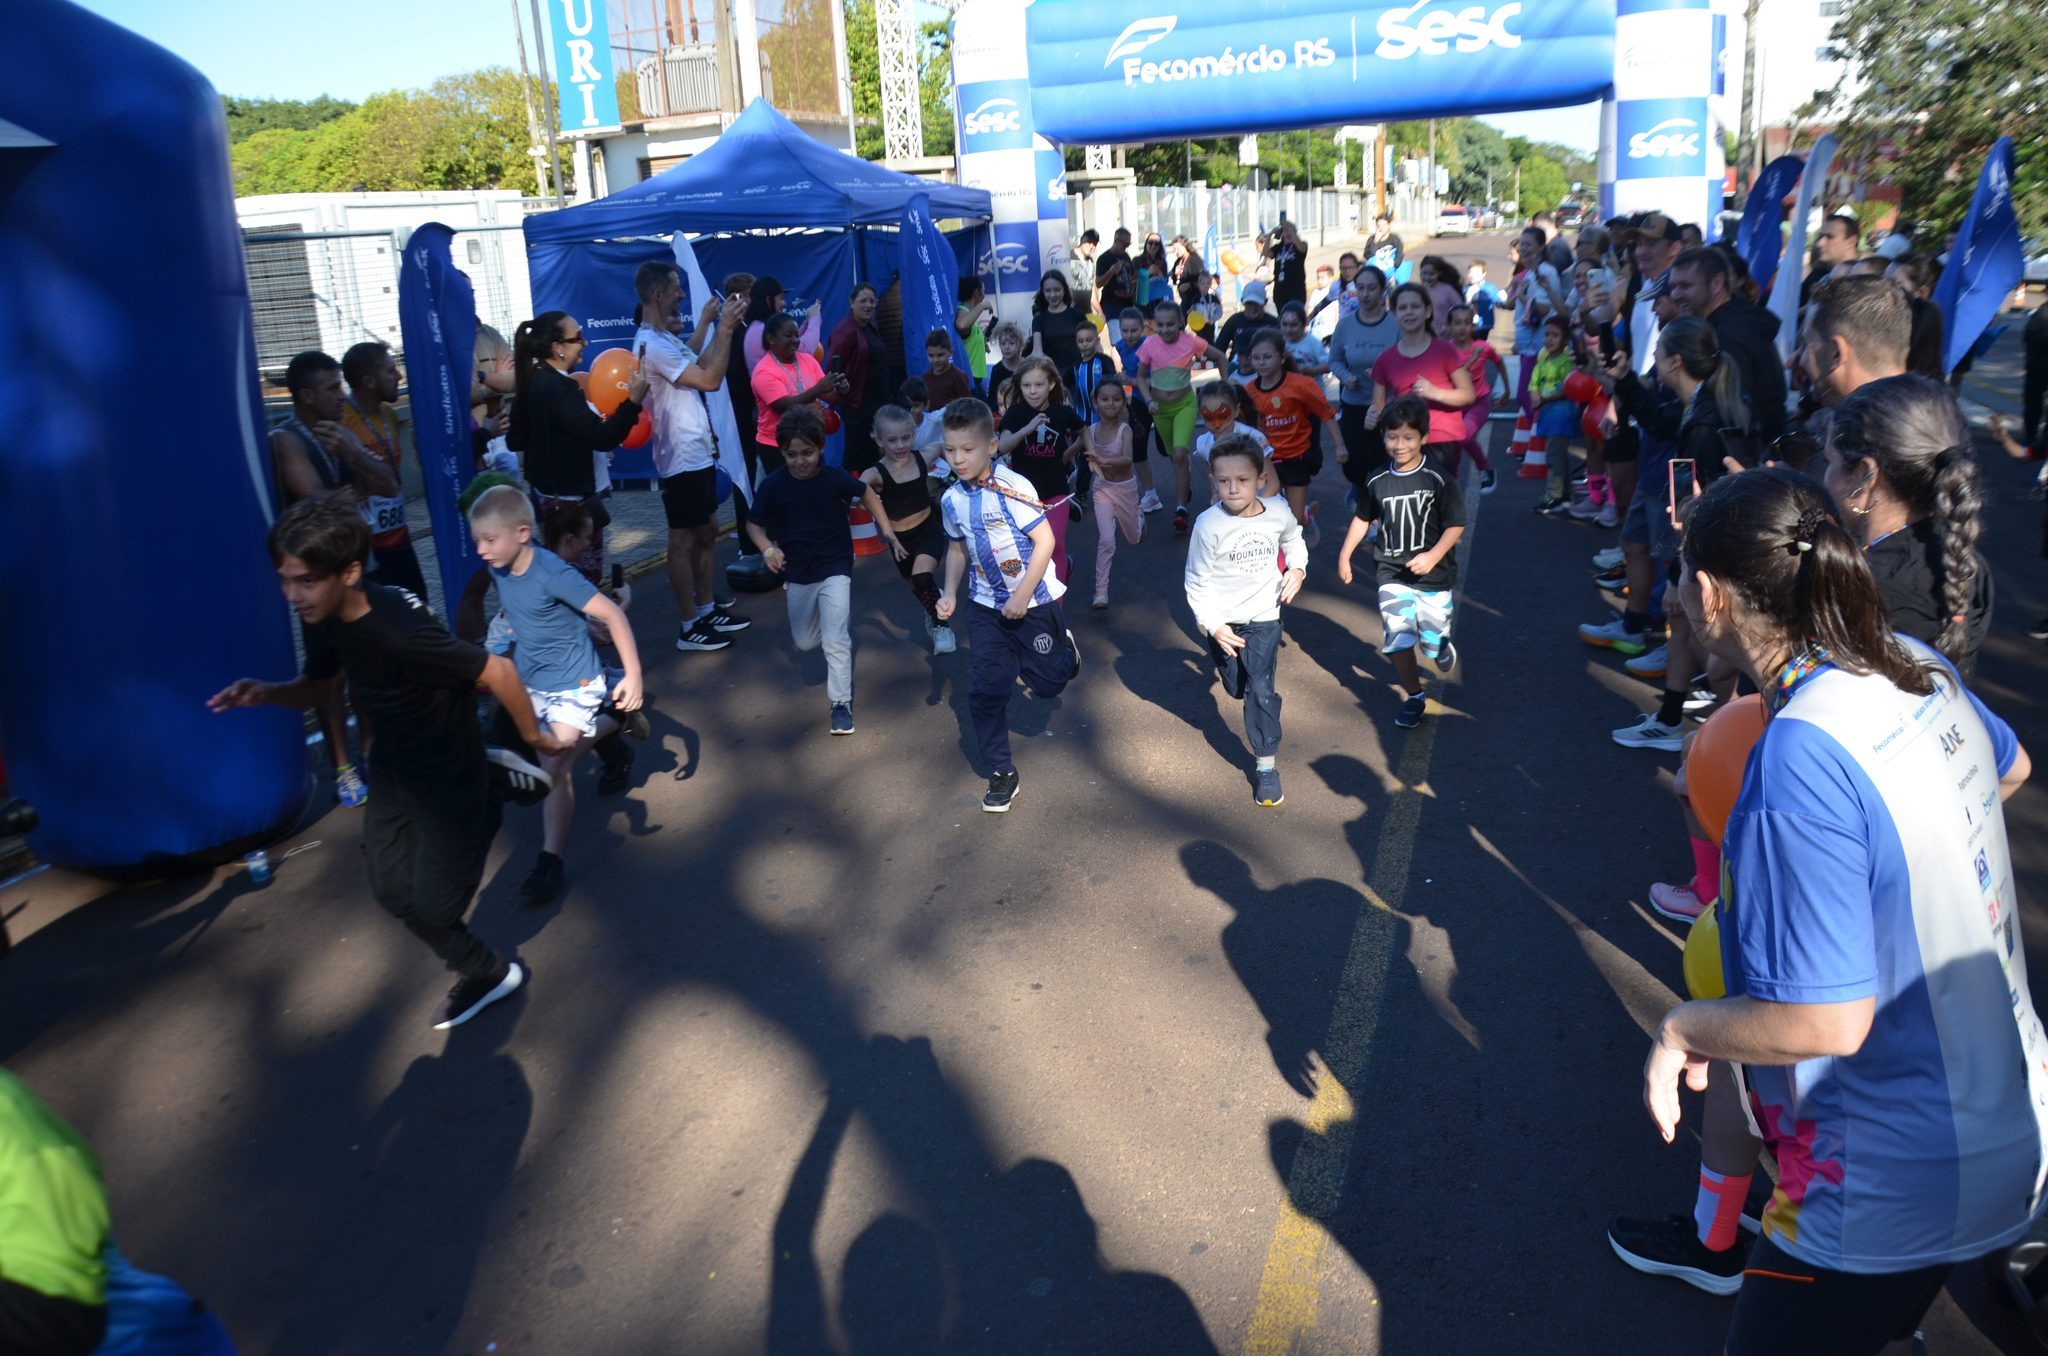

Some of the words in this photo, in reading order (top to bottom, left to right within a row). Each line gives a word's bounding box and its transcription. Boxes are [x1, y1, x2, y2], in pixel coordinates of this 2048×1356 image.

[1124, 46, 1286, 86] Fecomércio
[1295, 38, 1335, 69] RS
[587, 315, 635, 328] Fecomérc
[1229, 546, 1276, 562] MOUNTAINS
